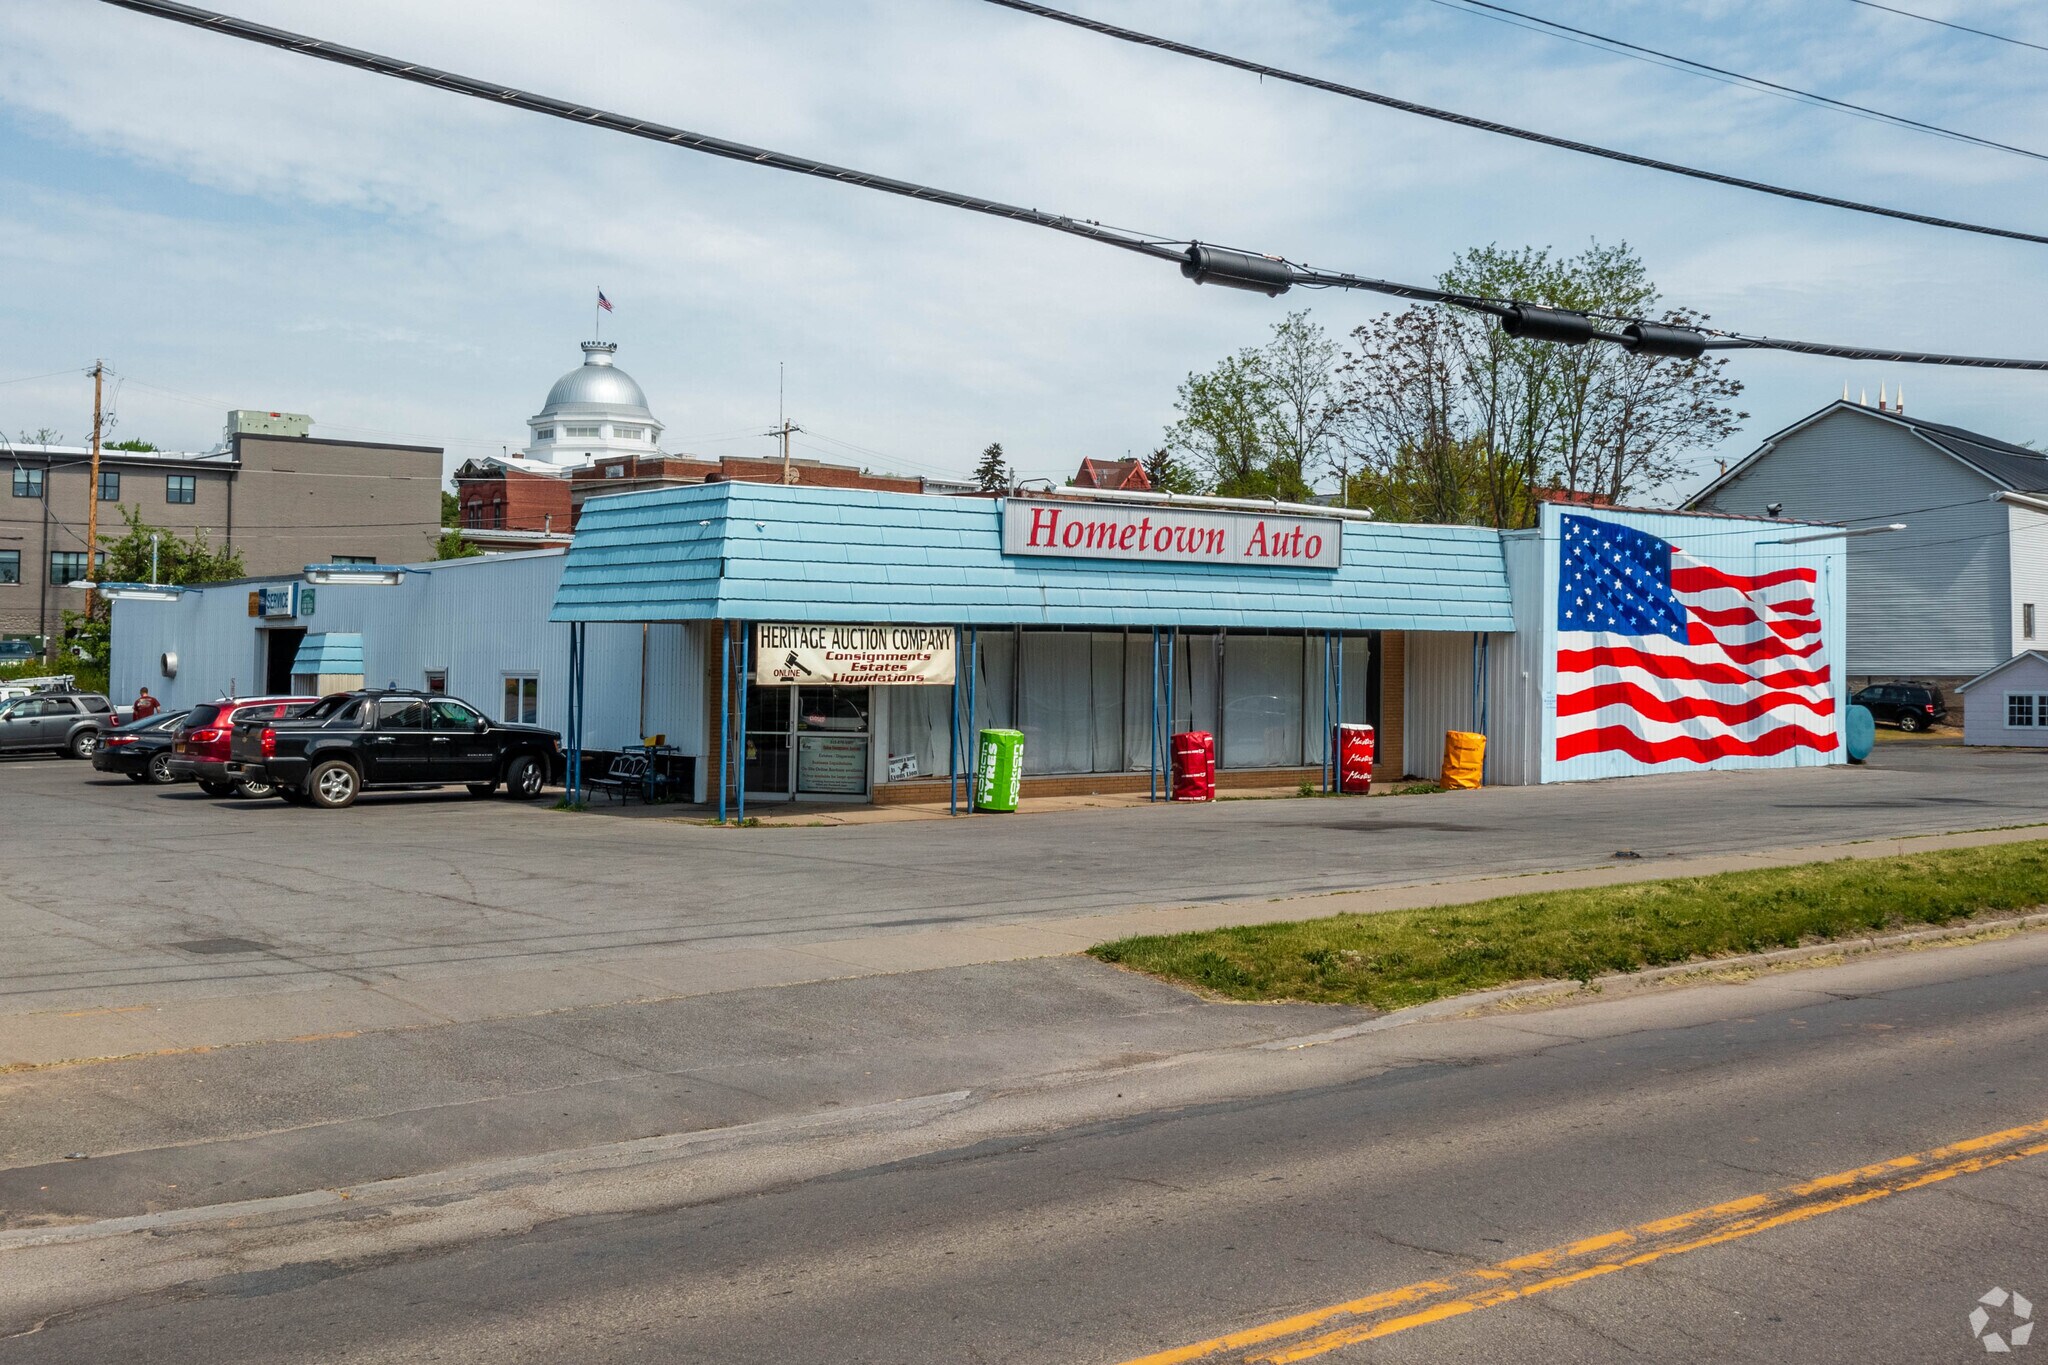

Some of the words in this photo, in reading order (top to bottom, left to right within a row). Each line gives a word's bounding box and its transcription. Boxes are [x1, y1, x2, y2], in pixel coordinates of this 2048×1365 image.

[1026, 507, 1225, 555] Hometown
[1244, 520, 1323, 559] Auto
[266, 592, 289, 609] SERVICE
[761, 626, 827, 649] HERITAGE
[832, 627, 887, 650] AUCTION
[892, 628, 952, 651] COMPANY
[826, 651, 931, 664] Consignments
[773, 669, 800, 677] ONLINE
[851, 662, 908, 672] Estates
[832, 673, 925, 684] Liquidations
[983, 742, 998, 804] TYRES
